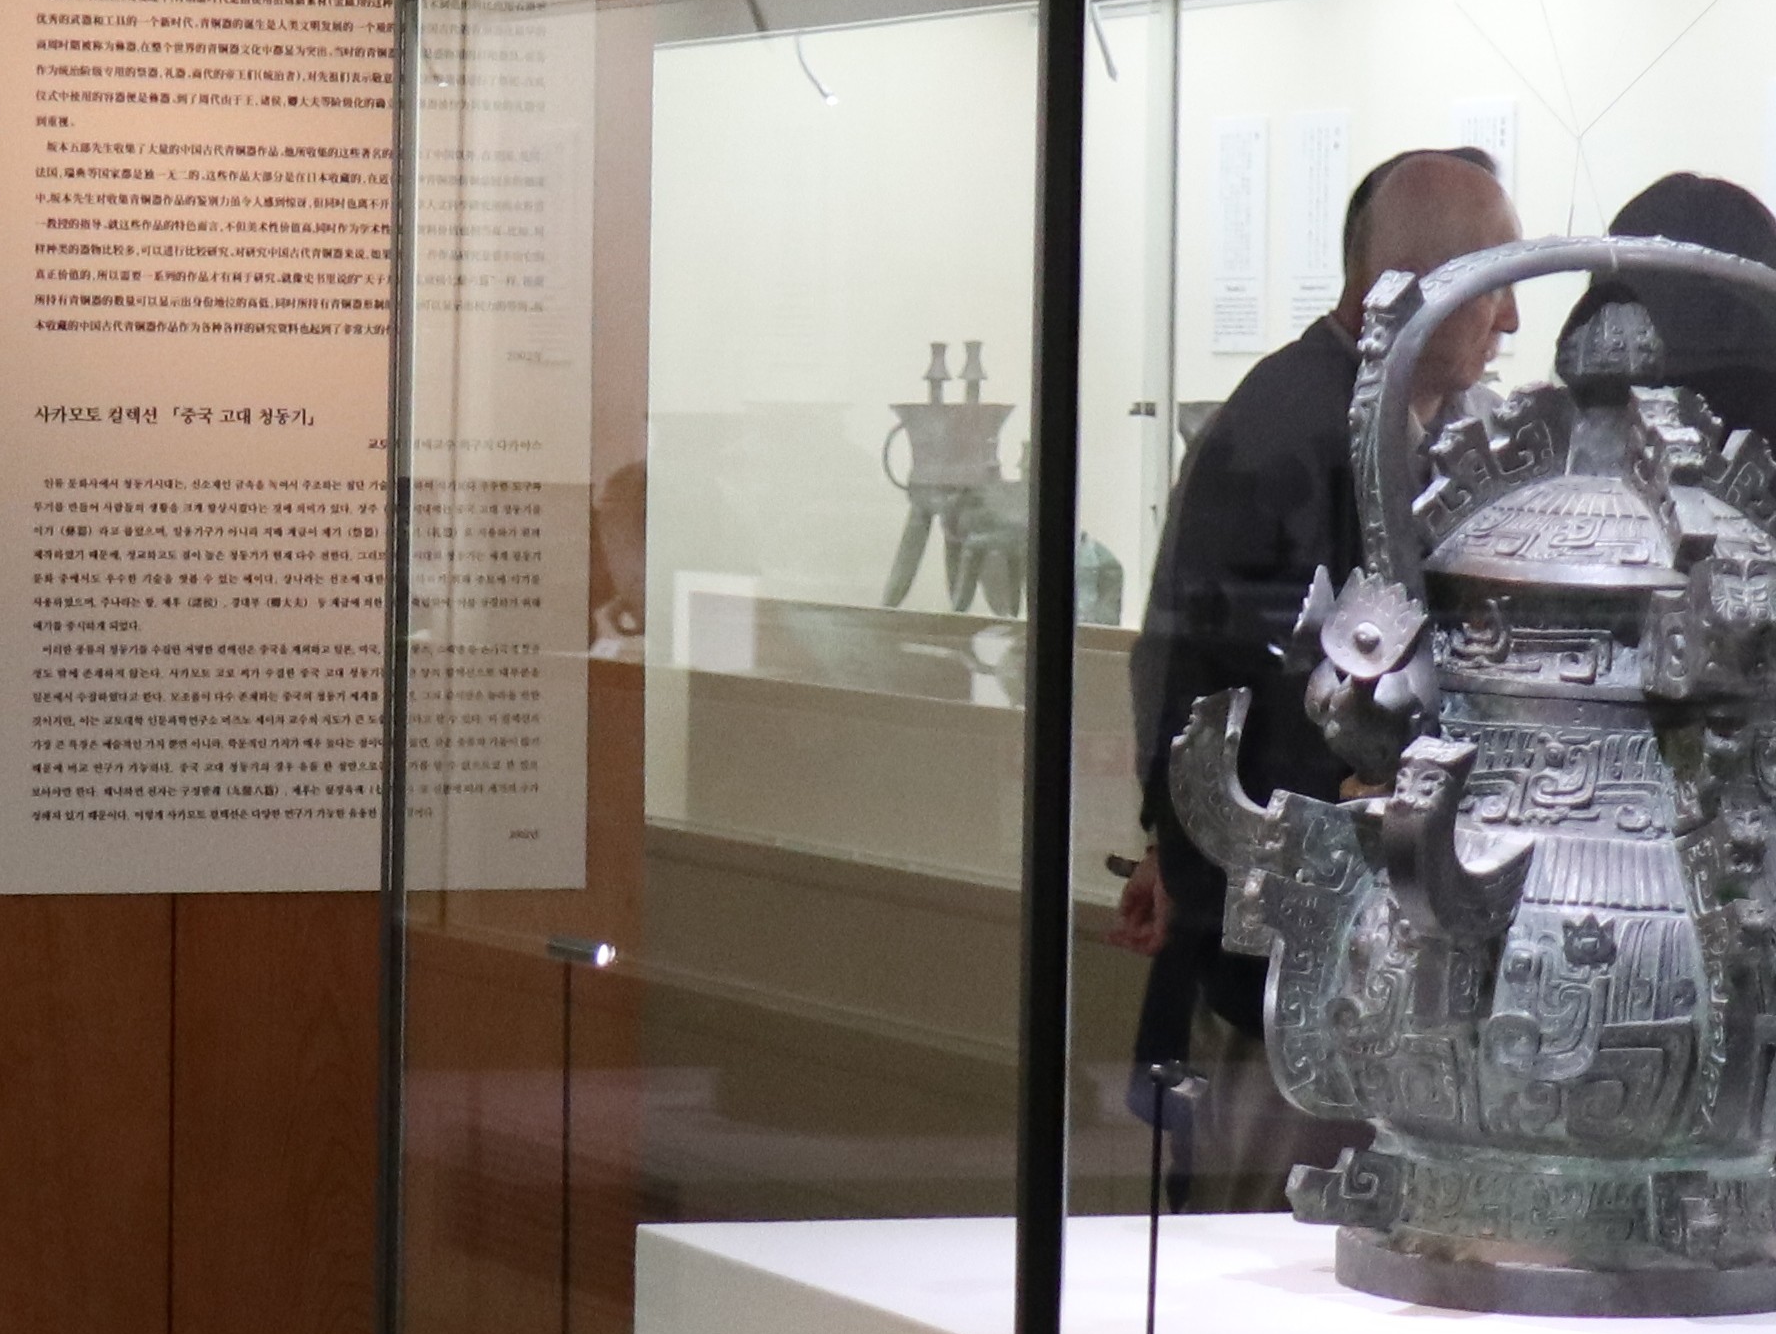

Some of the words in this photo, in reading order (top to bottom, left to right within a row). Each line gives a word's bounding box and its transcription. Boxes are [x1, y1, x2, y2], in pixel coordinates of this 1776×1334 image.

[34, 406, 103, 424] 사카모토
[107, 406, 158, 425] 컬렉션
[219, 408, 252, 425] 고대
